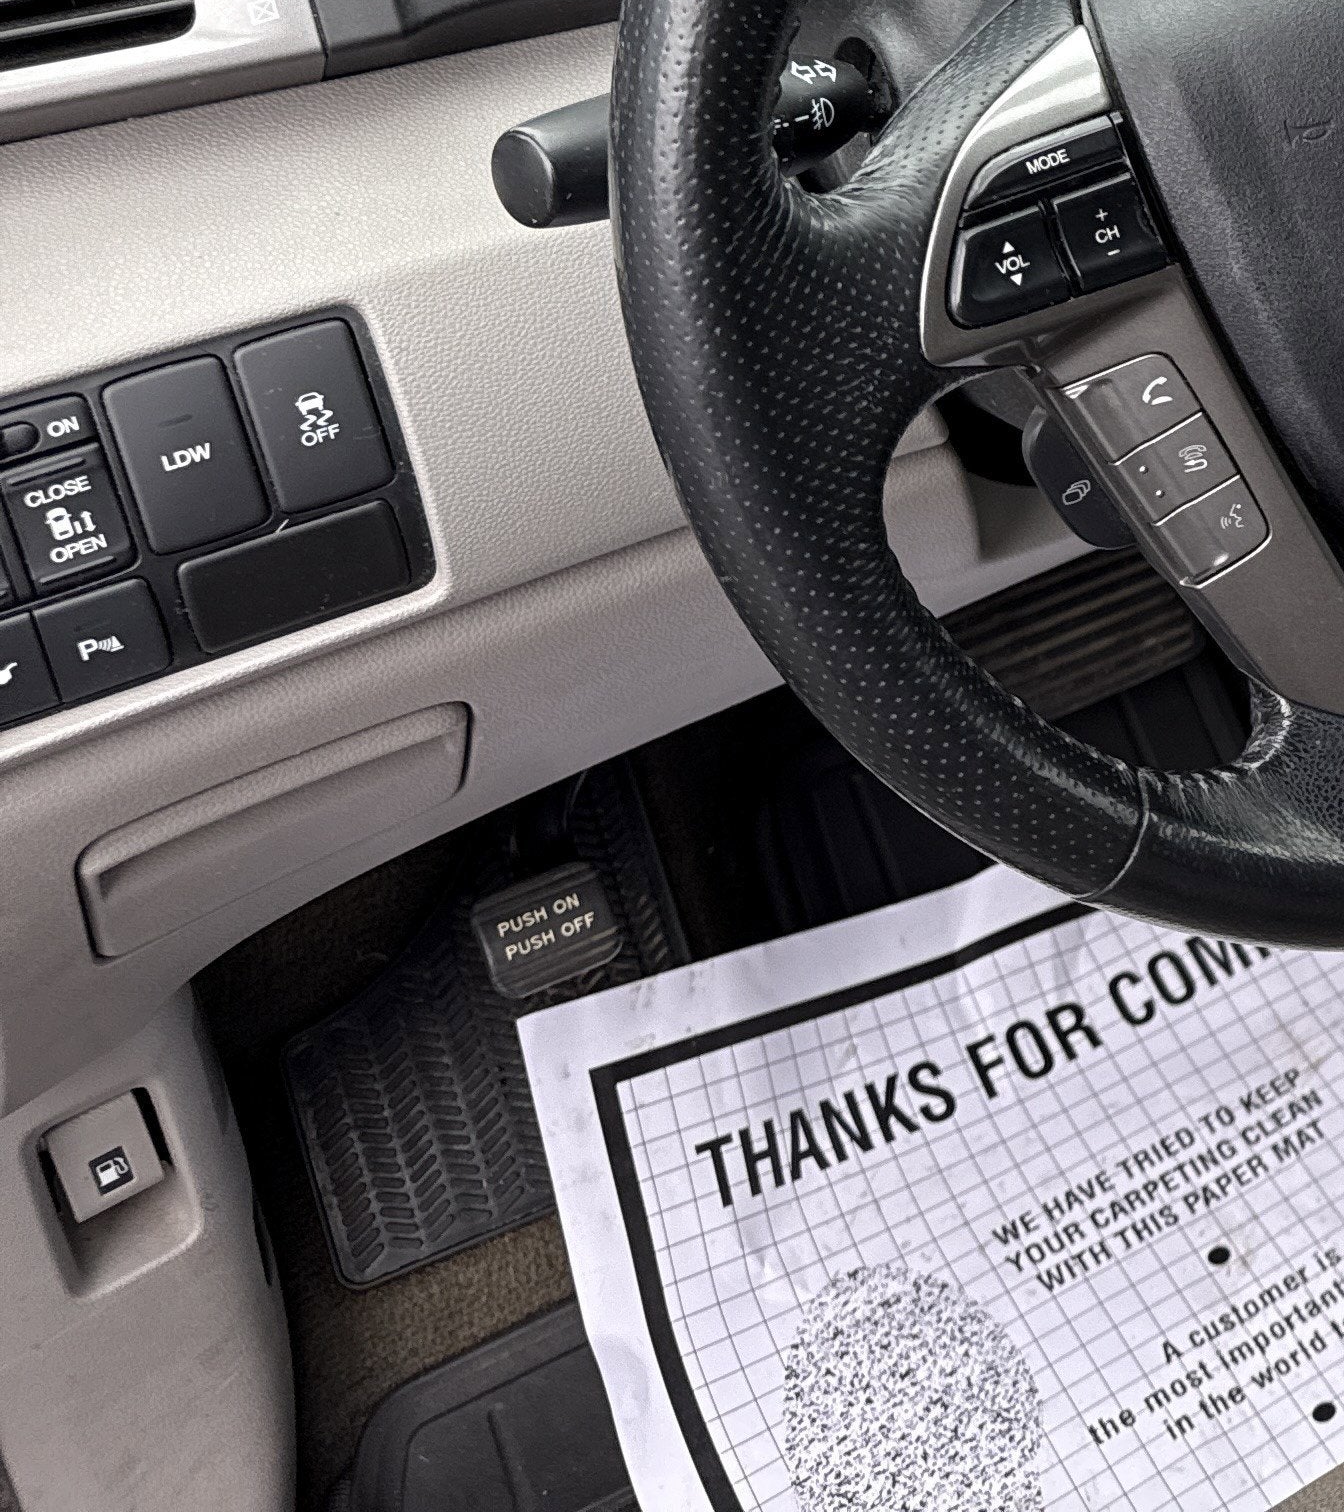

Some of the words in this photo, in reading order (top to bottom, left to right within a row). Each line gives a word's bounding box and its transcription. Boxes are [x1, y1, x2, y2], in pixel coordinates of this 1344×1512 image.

[1026, 148, 1070, 175] MODE
[1095, 226, 1121, 244] CH
[995, 256, 1029, 275] VOL
[47, 416, 80, 438] ON
[300, 423, 341, 447] OFF
[161, 442, 212, 472] LDW
[23, 474, 92, 508] CLOSE
[49, 533, 108, 564] OPEN
[497, 905, 549, 937] PUSH
[552, 892, 581, 917] ON
[504, 929, 556, 961] PUSH
[559, 910, 597, 943] OFF
[695, 1060, 957, 1209] THANKS
[966, 1001, 1103, 1100] FOR
[1108, 936, 1271, 1026] COM
[991, 1210, 1041, 1246] WE
[1041, 1170, 1116, 1223] HAVE
[1116, 1126, 1196, 1180] TRIED
[1199, 1105, 1236, 1134] TO
[1239, 1067, 1301, 1114] KEEP
[1005, 1220, 1086, 1273] YOUR
[1090, 1138, 1238, 1229] CARPETING
[1240, 1088, 1324, 1147] CLEAN
[1036, 1241, 1114, 1292] WITH
[1114, 1204, 1180, 1250] THIS
[1183, 1154, 1271, 1215] PAPER
[1271, 1118, 1325, 1163] MAT
[1162, 1339, 1183, 1364] A
[1188, 1266, 1309, 1350] customer
[1312, 1247, 1342, 1272] is
[1088, 1409, 1137, 1446] the
[1143, 1361, 1214, 1414] most
[1162, 1412, 1196, 1441] in
[1200, 1385, 1246, 1420] the
[1250, 1329, 1328, 1390] world
